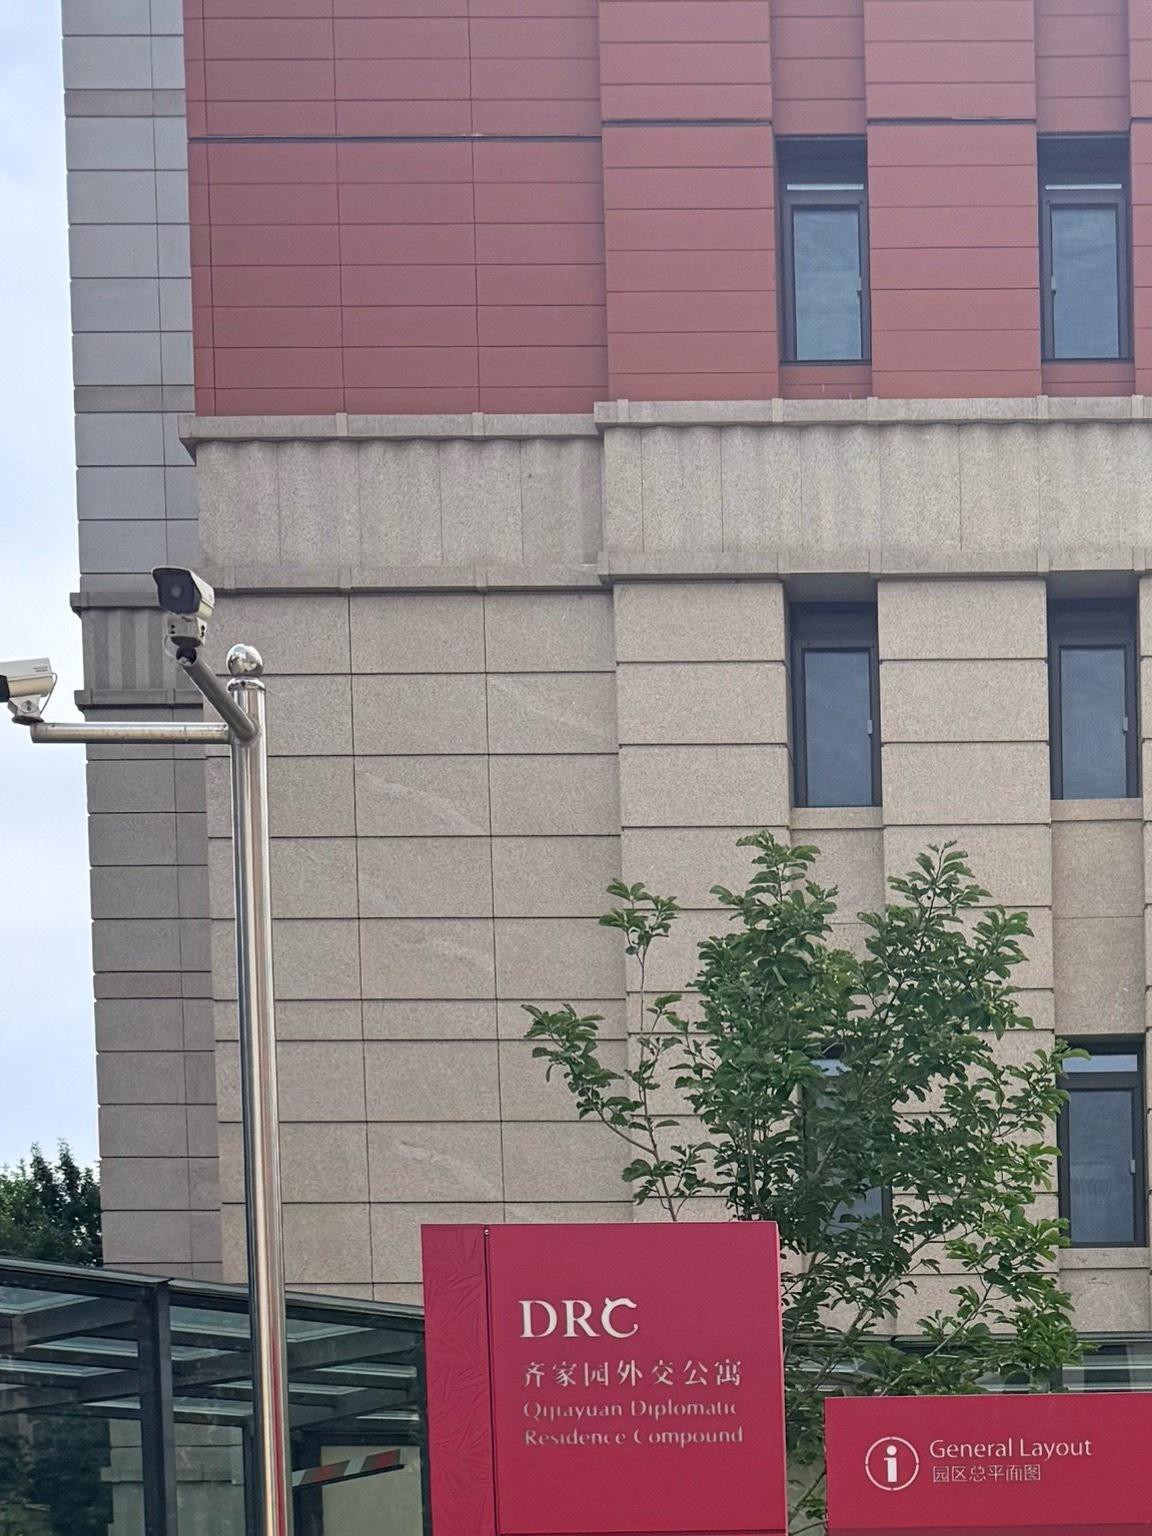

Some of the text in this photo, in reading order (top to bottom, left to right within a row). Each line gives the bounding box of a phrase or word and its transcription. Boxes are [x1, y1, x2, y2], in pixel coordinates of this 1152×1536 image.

[518, 1297, 639, 1339] DRC
[524, 1358, 742, 1387] 齐家园外交公寓
[523, 1399, 737, 1421] Qijiayuan Diplomatic
[525, 1426, 744, 1449] Residence Compound
[929, 1437, 1092, 1461] General Layout
[932, 1464, 1041, 1483] 园区总平面图
